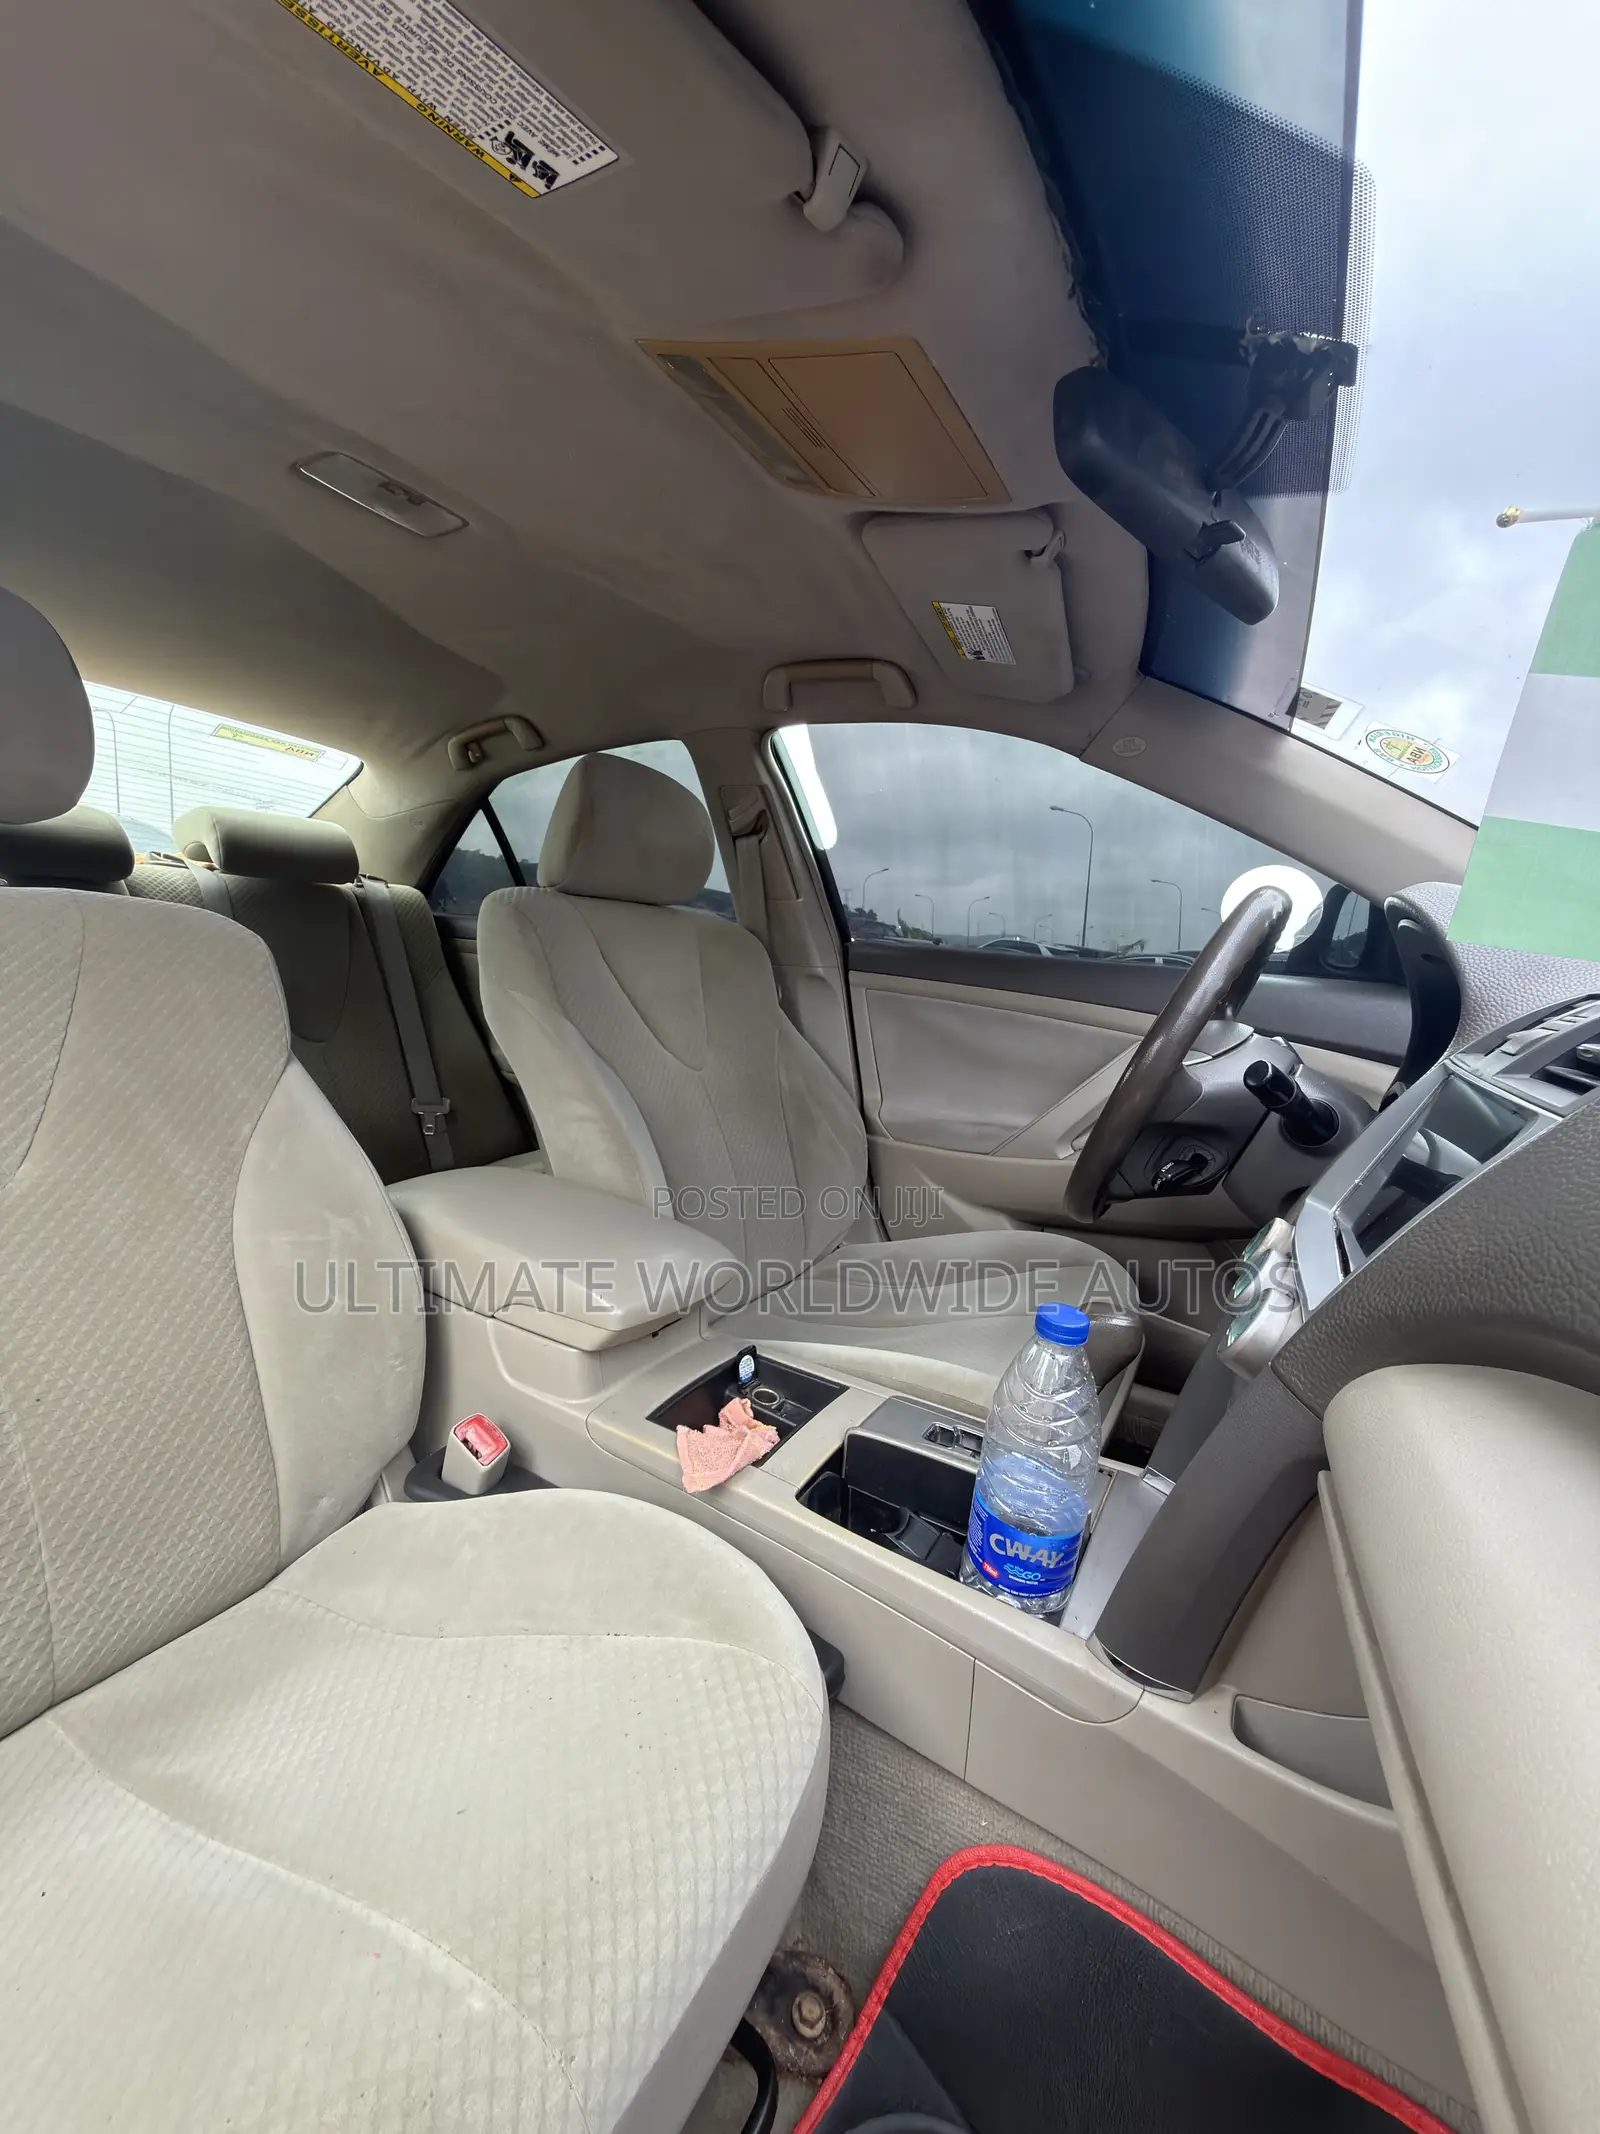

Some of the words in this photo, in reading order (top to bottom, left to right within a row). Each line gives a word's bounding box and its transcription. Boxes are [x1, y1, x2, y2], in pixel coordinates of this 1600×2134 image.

[324, 20, 400, 79] ADVANCED
[405, 85, 438, 110] WITH
[414, 103, 486, 157] WARNING
[443, 115, 475, 139] EVEN
[989, 1533, 1064, 1569] CWAY
[1023, 1571, 1041, 1581] GO
